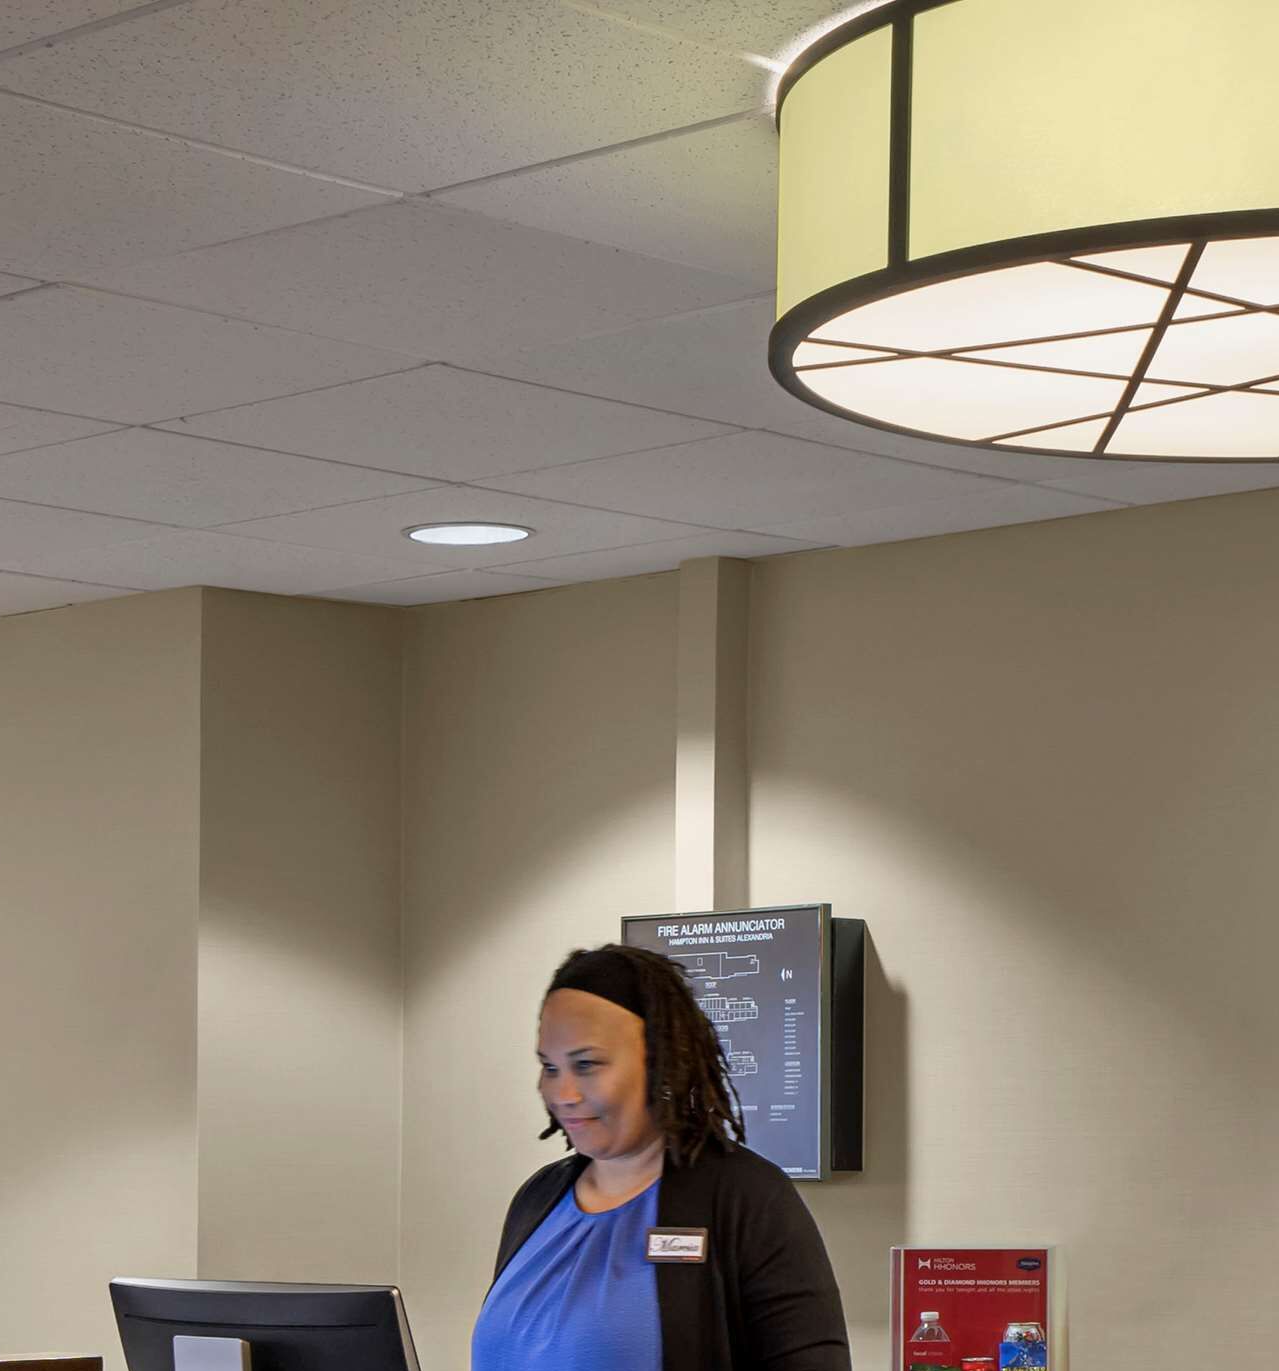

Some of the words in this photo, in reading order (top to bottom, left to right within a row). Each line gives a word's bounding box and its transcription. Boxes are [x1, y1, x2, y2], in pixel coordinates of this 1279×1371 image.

[657, 925, 679, 937] FIRE
[680, 923, 713, 936] ALARM
[714, 918, 785, 934] ANNUNCIATOR
[668, 937, 698, 946] HAMPTON
[715, 934, 736, 943] SUITES
[736, 932, 774, 942] ALEXANDRIA
[786, 970, 793, 979] N
[933, 1263, 977, 1271] HHONORS
